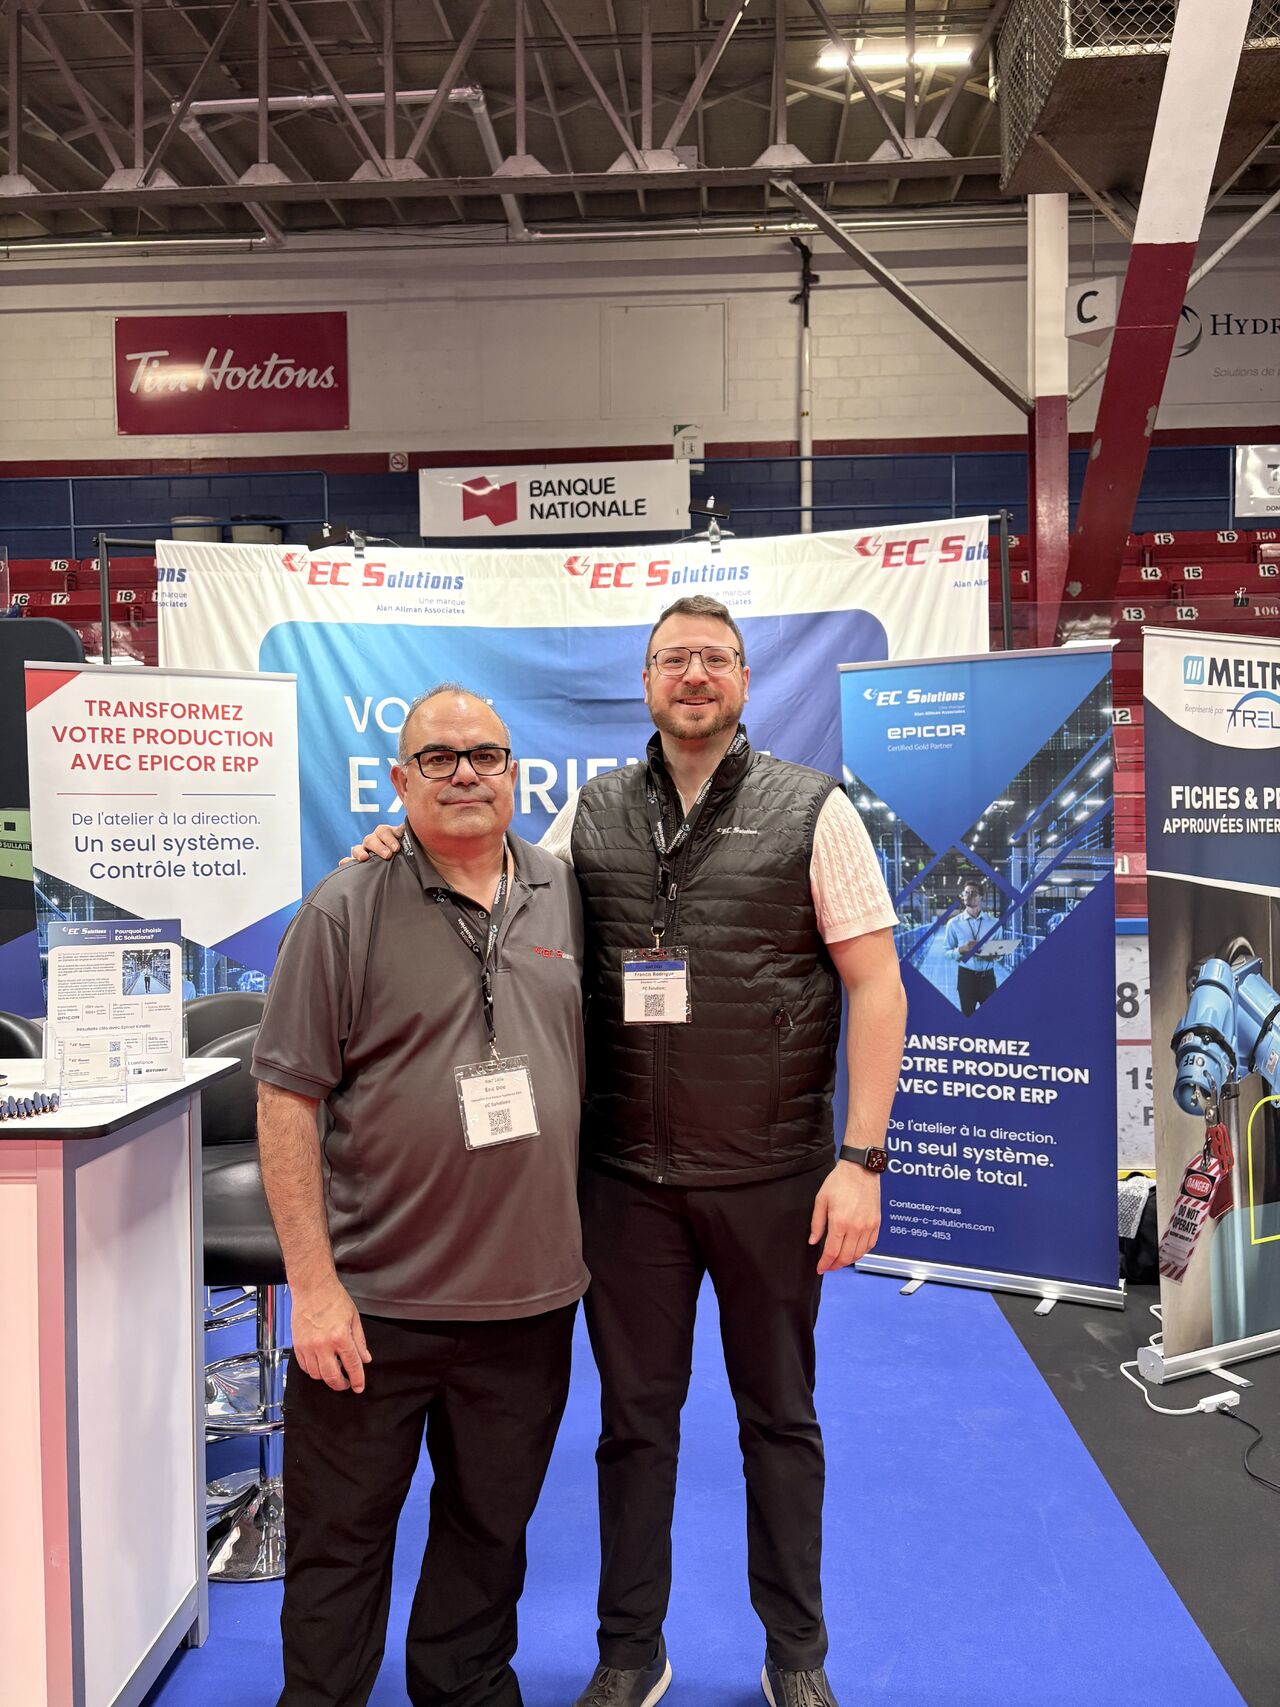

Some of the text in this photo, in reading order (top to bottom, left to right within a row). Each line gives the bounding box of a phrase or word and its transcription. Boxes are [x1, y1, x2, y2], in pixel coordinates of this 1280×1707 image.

[1077, 290, 1099, 323] C
[126, 347, 335, 393] Tim Hortons
[1213, 367, 1259, 377] Solutions
[1261, 367, 1275, 376] de
[530, 477, 616, 497] BANQUE
[530, 498, 647, 519] NATIONALE
[1157, 535, 1171, 544] 15
[1220, 532, 1236, 541] 16
[881, 538, 930, 569] EC
[54, 561, 67, 570] 16
[589, 559, 750, 589] EC Solutions
[1143, 569, 1159, 578] 14
[1186, 568, 1201, 577] 15
[1261, 566, 1277, 575] 16
[308, 560, 464, 590] EC Solutions
[953, 580, 972, 588] Alan
[14, 595, 28, 604] 16
[53, 594, 67, 603] 17
[119, 591, 133, 601] 18
[436, 598, 466, 607] marque
[376, 604, 465, 615] Alan Allman Associates
[1126, 610, 1143, 619] 13
[876, 689, 966, 706] EC Solutions
[84, 699, 243, 721] TRANSFORMEZ
[1184, 703, 1224, 715] Représenté par
[51, 725, 274, 748] VOTRE PRODUCTION
[888, 742, 913, 752] Certified
[914, 743, 929, 751] Gold
[70, 753, 259, 773] AVEC EPICOR ERP
[1170, 785, 1240, 810] FICHES
[1244, 786, 1258, 810] &
[72, 811, 261, 826] De l'atelier à la direction.
[1162, 814, 1243, 834] APPROUVÉES
[74, 833, 260, 856] Un seul système.
[89, 859, 247, 880] Contrôle total.
[900, 1056, 1089, 1085] OTRE PRODUCTION
[895, 1078, 1058, 1104] VEC EPICOR ERP
[887, 1118, 1057, 1145] De l'atelier à la direction.
[887, 1137, 1055, 1168] Un seul système.
[887, 1159, 1028, 1187] Contrôle total.
[1186, 1176, 1210, 1193] DANGER
[889, 1199, 962, 1215] Contactez-nous
[1177, 1204, 1200, 1221] DO NOT
[889, 1214, 995, 1233] www.e-c-solutions.com
[1172, 1216, 1198, 1235] OPERATE
[890, 1226, 951, 1241] 866-959-4153
